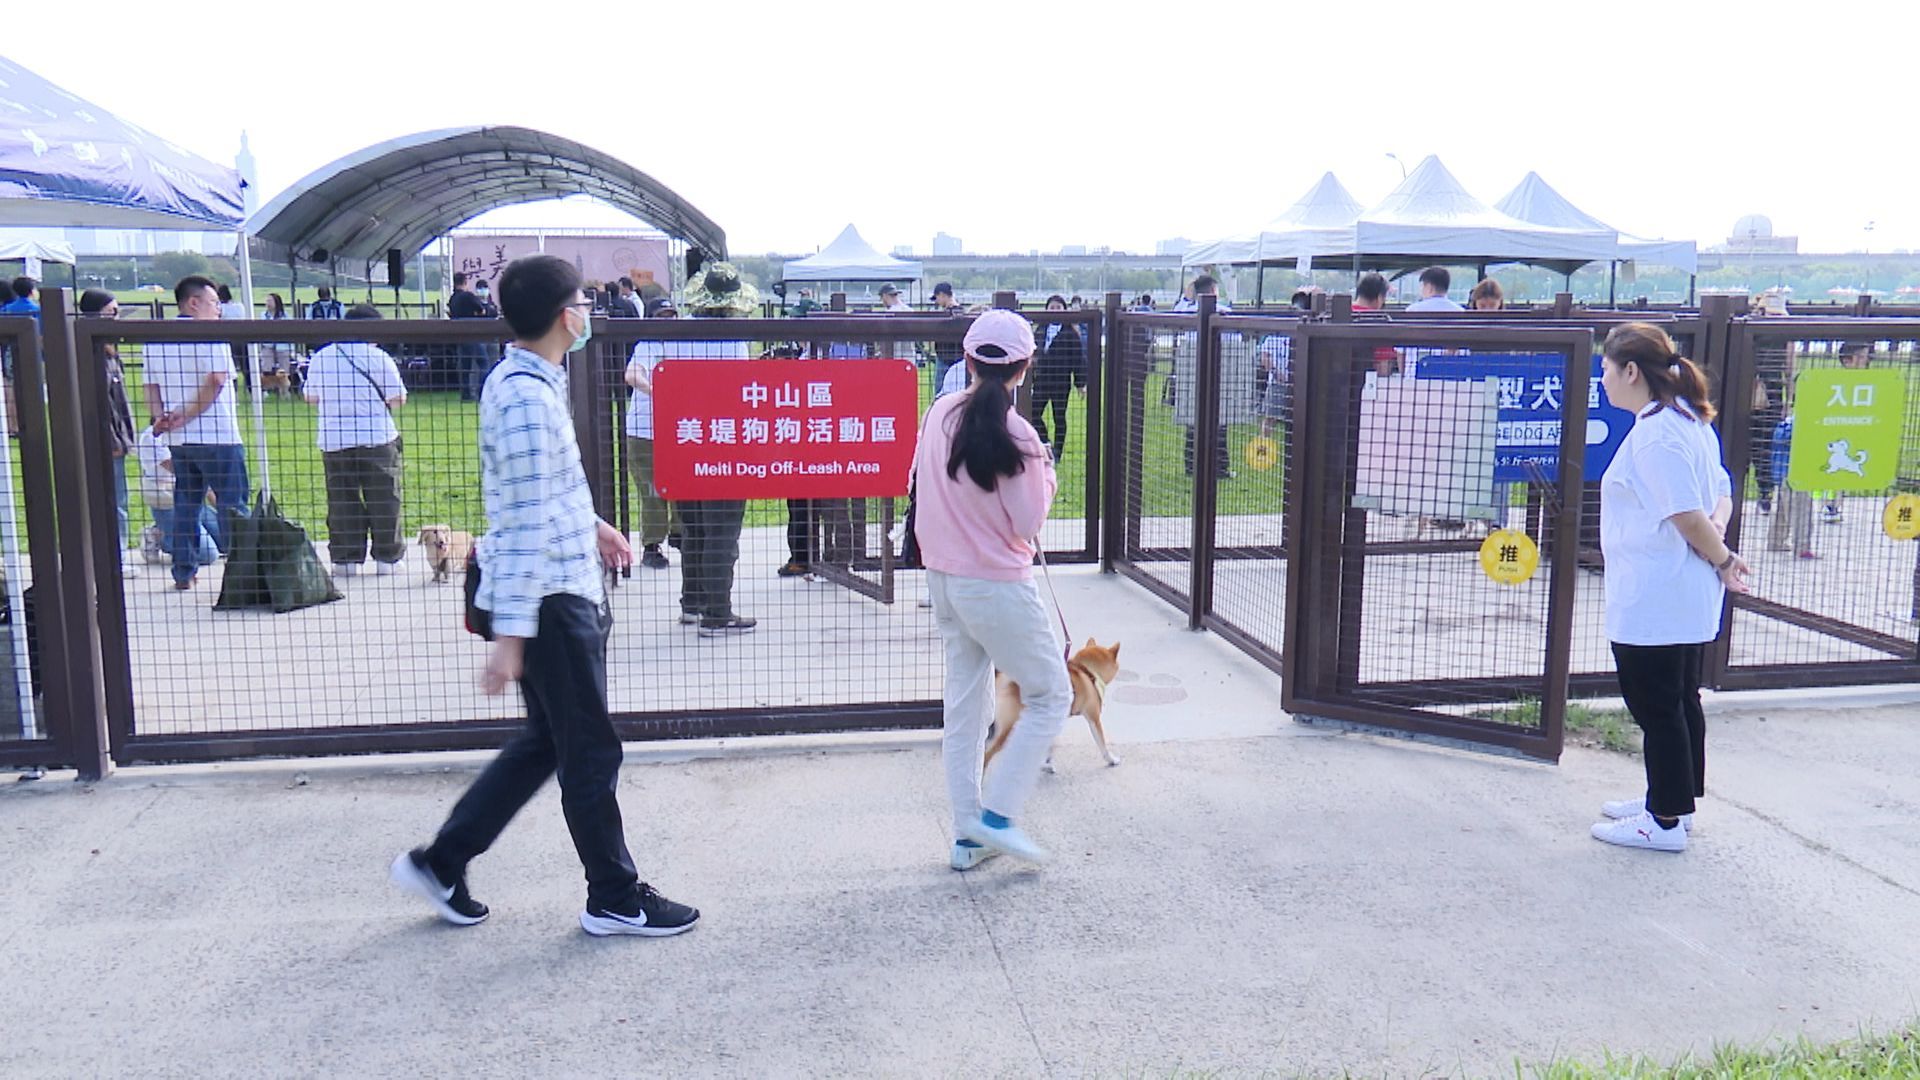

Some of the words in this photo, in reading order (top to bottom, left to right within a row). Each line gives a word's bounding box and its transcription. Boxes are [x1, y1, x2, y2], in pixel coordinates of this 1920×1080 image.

[742, 381, 832, 408] 中山區
[1827, 384, 1873, 407] 入口
[676, 417, 896, 444] 美堤狗狗活動區
[1514, 427, 1543, 440] DOG
[694, 461, 732, 476] Meiti
[736, 462, 767, 478] Dog
[770, 461, 843, 475] Off-Leash
[846, 461, 880, 474] Area
[1499, 544, 1518, 562] 推
